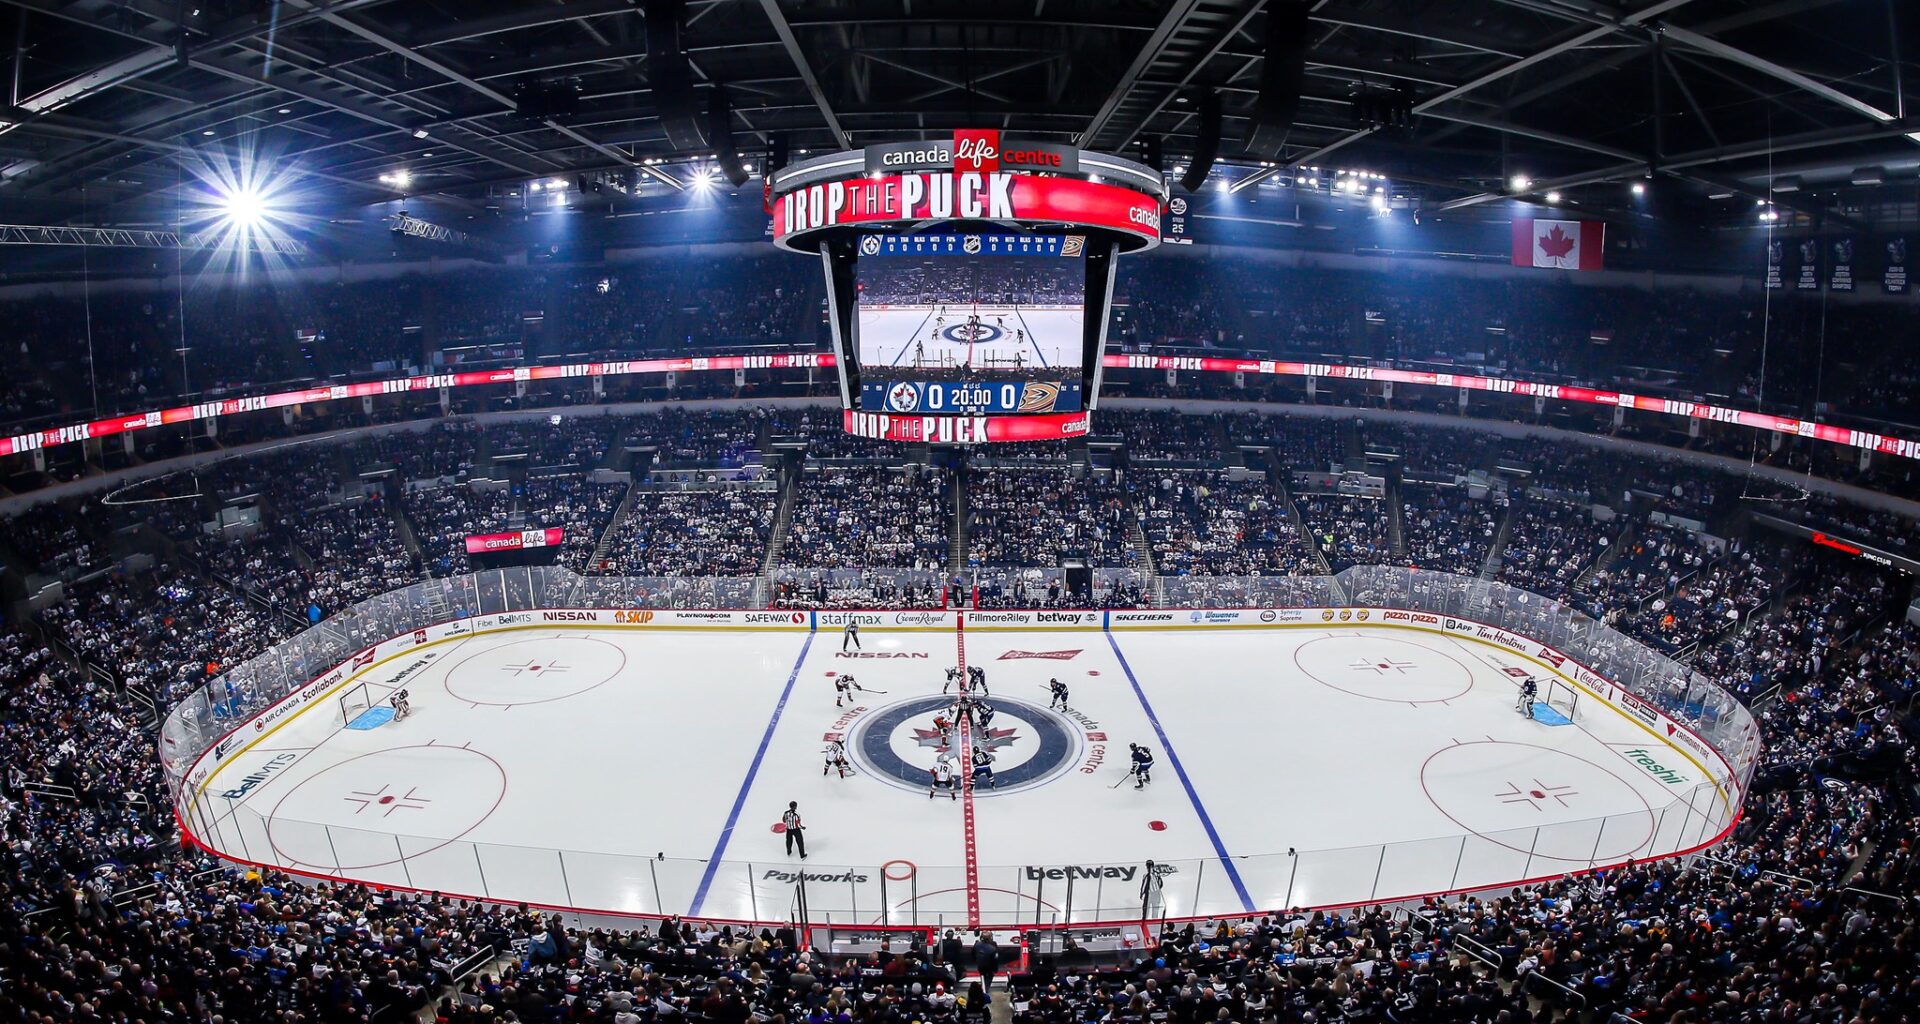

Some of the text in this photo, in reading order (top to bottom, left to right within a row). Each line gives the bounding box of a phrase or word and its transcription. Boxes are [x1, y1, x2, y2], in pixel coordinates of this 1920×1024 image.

[883, 138, 1062, 168] canada life centre
[785, 173, 1015, 234] DROP THE PUCK
[1129, 205, 1161, 229] canada
[1172, 224, 1184, 233] 25
[561, 362, 630, 376] DROP THE PUCK
[744, 354, 818, 368] DROP THE PUCK
[1129, 356, 1202, 370] DROP THE PUCK
[1236, 363, 1260, 371] canada
[1304, 363, 1373, 379] DROP THE PUCK
[383, 375, 454, 393] DROP THE PUCK
[1486, 378, 1560, 398] DROP THE PUCK
[928, 384, 943, 409] 0
[951, 390, 991, 406] 20:00
[1001, 384, 1015, 409] 0
[193, 396, 267, 418] DROP THE PUCK
[1664, 400, 1740, 423] DROP THE PUCK
[852, 412, 988, 442] DROP THE PUCK
[1061, 419, 1087, 434] canada
[11, 423, 90, 452] DROP THE PUCK
[1850, 430, 1881, 450] DROP
[1881, 438, 1897, 453] THE
[485, 532, 544, 548] canada life
[477, 616, 493, 628] Fibe
[498, 613, 531, 624] BellMTS
[543, 611, 597, 621] NISSAN
[626, 611, 654, 623] SKIP
[745, 613, 790, 623] SAFEWAY
[822, 613, 882, 624] staffmax
[895, 612, 946, 624] Crown Royal
[1037, 612, 1081, 624] betway
[1383, 611, 1438, 624] pizza pizza
[1477, 626, 1526, 651] Tim Hortons
[386, 659, 428, 684] betway
[302, 670, 343, 702] Scotiabank
[264, 698, 300, 724] AIR CANADA
[832, 706, 869, 730] centre
[1676, 730, 1710, 760] CANADIAN TIRE
[975, 754, 985, 764] 81
[1080, 744, 1106, 775] centre
[940, 765, 948, 773] 19
[1624, 749, 1690, 786] freshii
[221, 753, 296, 799] BellMTS
[763, 869, 868, 884] Payworks
[1026, 865, 1137, 881] betway
